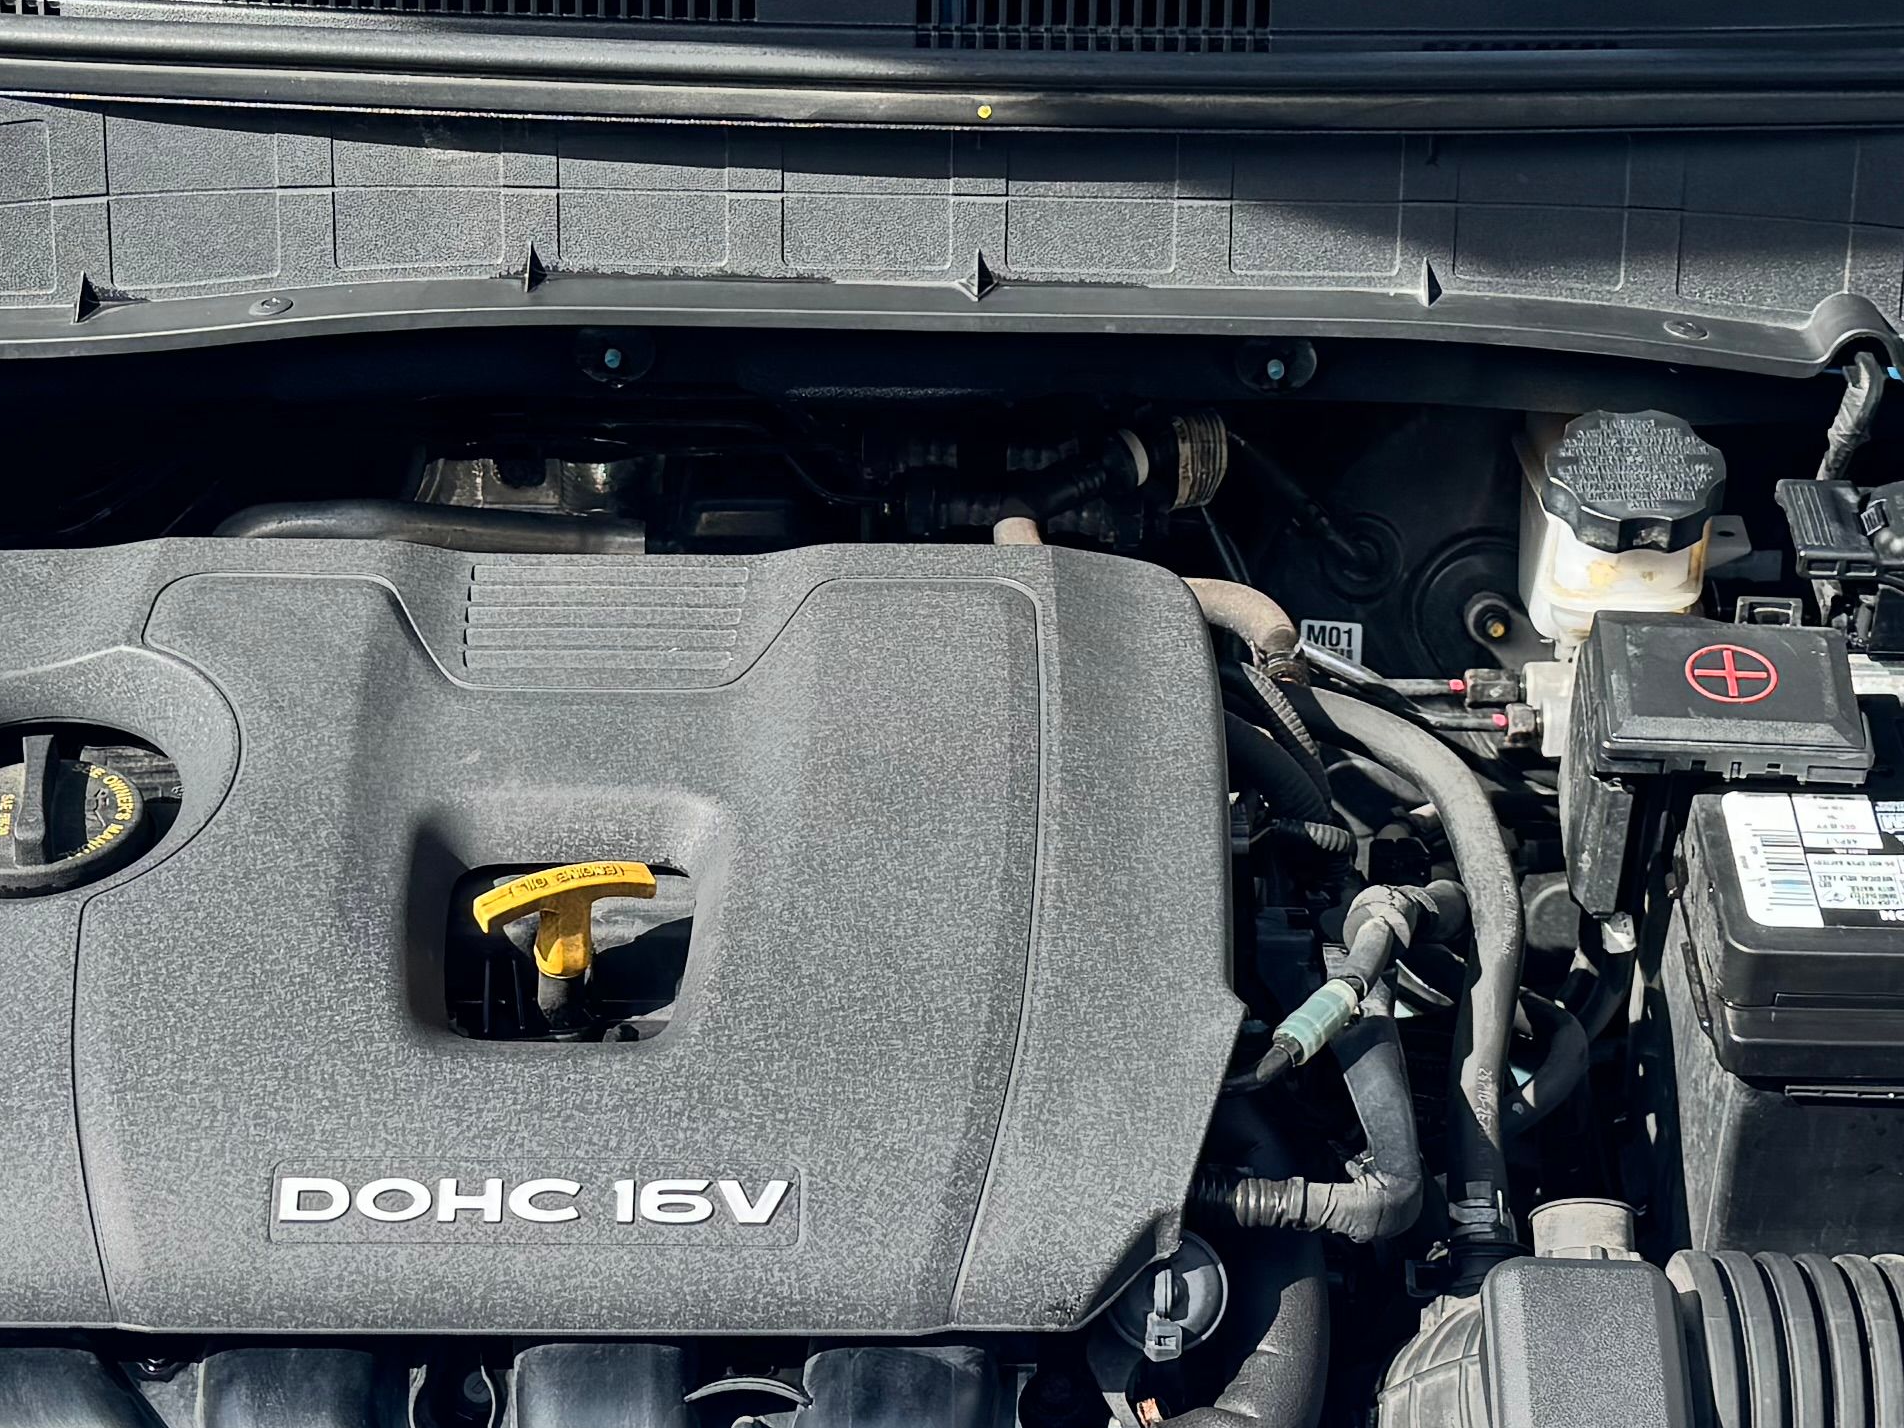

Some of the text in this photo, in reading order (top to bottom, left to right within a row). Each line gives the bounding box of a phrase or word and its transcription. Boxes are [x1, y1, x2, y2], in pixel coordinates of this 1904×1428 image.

[1307, 625, 1352, 647] M01
[278, 1176, 795, 1226] DOHC 16V
